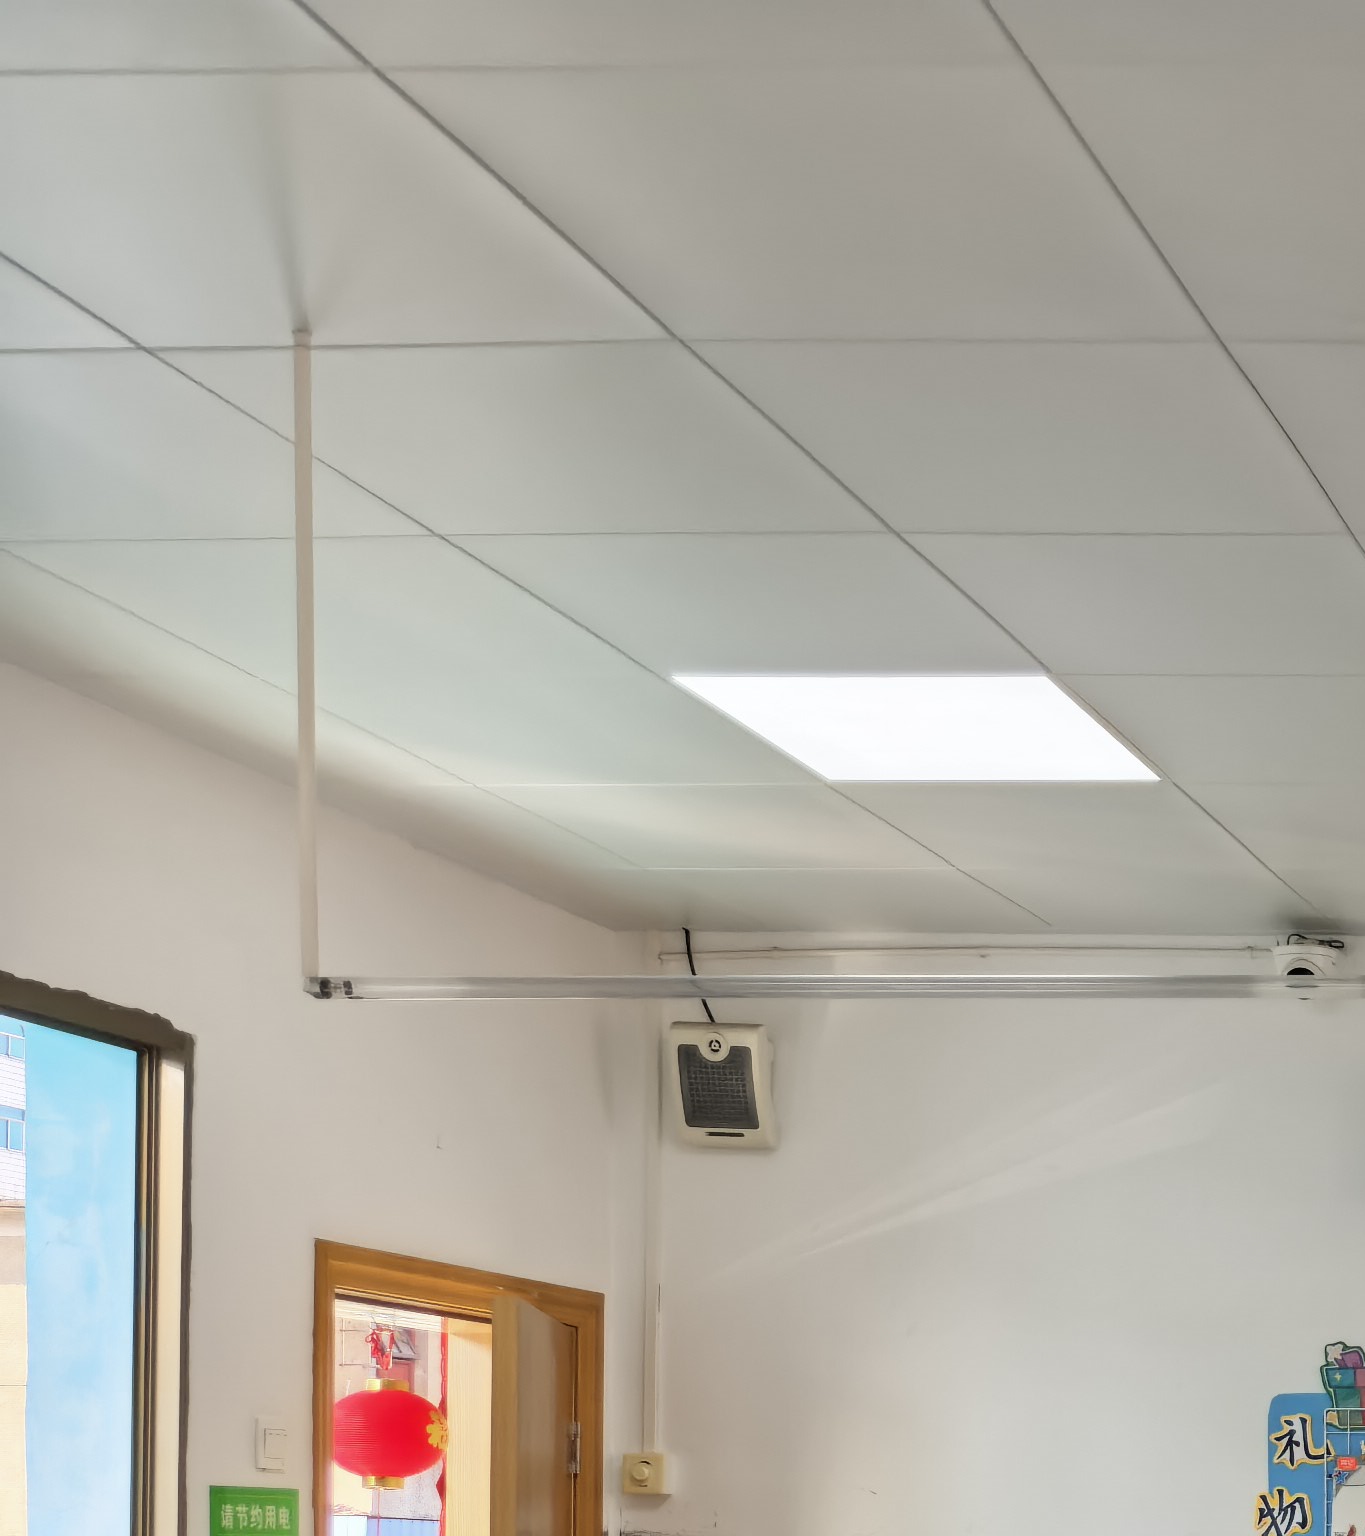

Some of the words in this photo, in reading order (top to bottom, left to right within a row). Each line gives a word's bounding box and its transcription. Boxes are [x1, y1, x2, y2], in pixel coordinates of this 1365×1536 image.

[221, 1503, 291, 1530] 请节约用电
